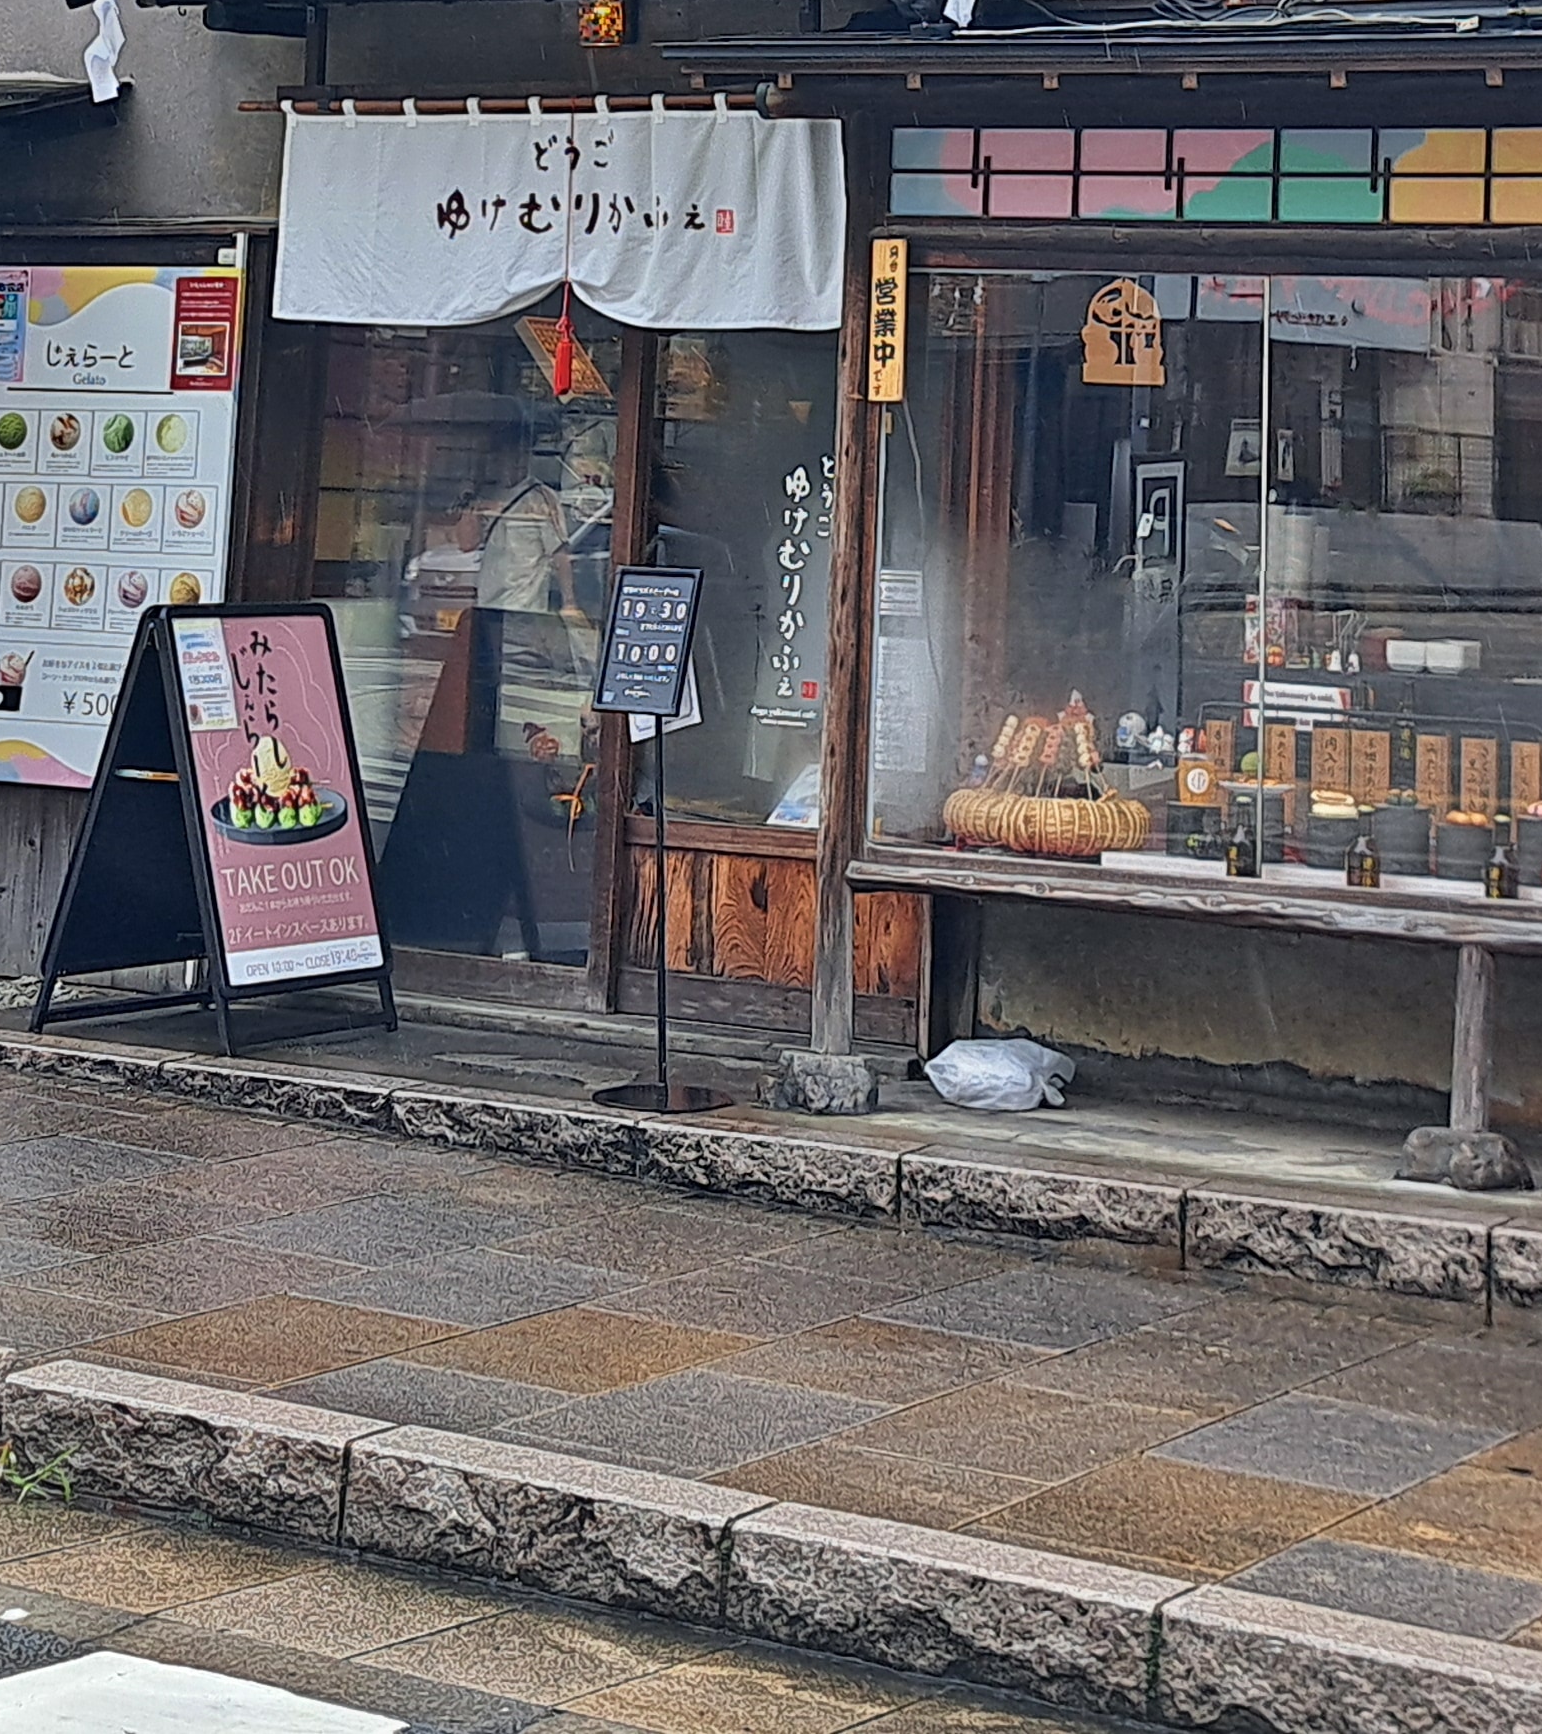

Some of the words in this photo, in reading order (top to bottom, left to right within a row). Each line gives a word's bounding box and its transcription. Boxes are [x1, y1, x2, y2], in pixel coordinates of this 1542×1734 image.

[533, 129, 615, 172] どうご
[47, 339, 135, 368] じぇらーと
[73, 373, 106, 385] Gelato
[622, 599, 687, 620] 19:30
[617, 643, 677, 662] 10:00
[221, 864, 278, 897] TAKE
[281, 858, 323, 890] OUT
[329, 855, 360, 885] OK
